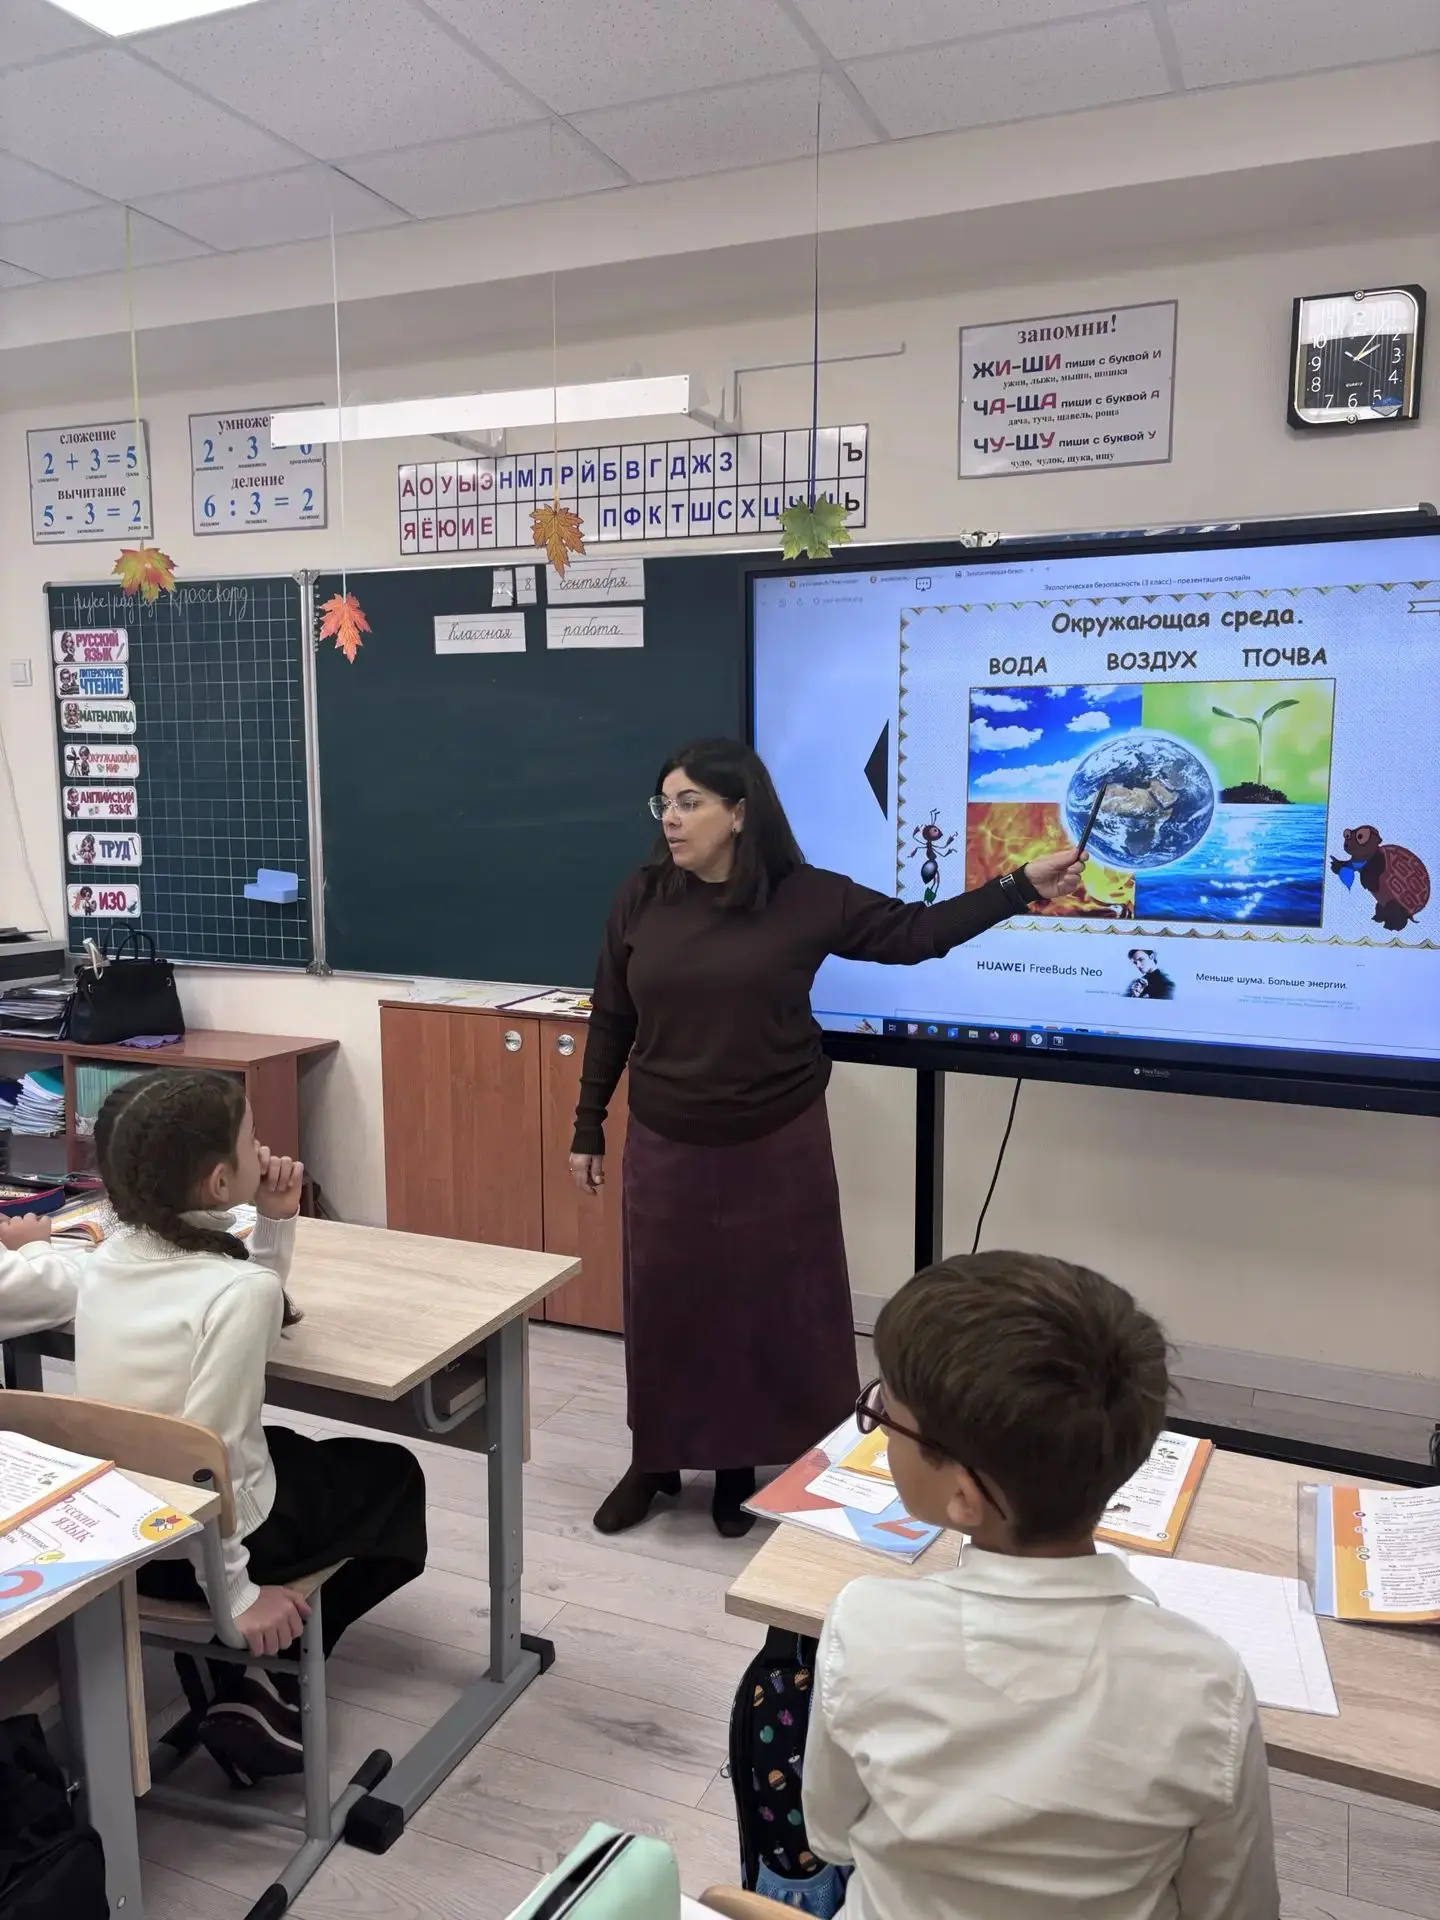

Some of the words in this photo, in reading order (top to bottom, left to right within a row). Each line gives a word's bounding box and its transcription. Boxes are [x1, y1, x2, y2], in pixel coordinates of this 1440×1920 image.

[1017, 314, 1117, 344] запомни!
[1312, 333, 1327, 349] 10
[972, 353, 1062, 379] ЖИ-ШИ
[1065, 359, 1096, 369] пиши
[1098, 357, 1105, 365] с
[1109, 351, 1149, 366] буквой
[1152, 349, 1161, 359] И
[1311, 356, 1321, 372] 9
[1391, 347, 1401, 364] 3
[1311, 376, 1321, 393] 8
[1388, 369, 1399, 385] 4
[1061, 398, 1092, 409] пиши
[1095, 397, 1102, 405] с
[1105, 391, 1147, 406] буквой
[1150, 390, 1160, 399] А
[1324, 394, 1334, 409] 7
[1347, 393, 1358, 409] 6
[217, 415, 271, 435] умноже
[1007, 416, 1031, 426] дача,
[1032, 414, 1055, 425] туча,
[1095, 408, 1119, 420] роща
[59, 429, 117, 445] сложение
[1058, 437, 1090, 448] пиши
[1093, 436, 1100, 445] с
[1103, 431, 1145, 446] буквой
[1148, 430, 1157, 439] У
[203, 439, 215, 463] 2
[246, 435, 259, 460] 3
[43, 452, 55, 475] 2
[90, 448, 101, 472] 3
[126, 445, 138, 469] 5
[1036, 456, 1065, 467] чулок,
[230, 473, 285, 490] деление
[57, 486, 127, 500] вычитание
[204, 494, 216, 518] 6
[249, 491, 261, 516] 3
[302, 487, 314, 512] 2
[43, 504, 55, 527] 5
[84, 502, 96, 525] 3
[132, 499, 142, 523] 2
[524, 577, 533, 591] 8
[1043, 583, 1093, 592] Экологическая
[1094, 579, 1140, 589] безопасность
[1150, 577, 1173, 587] класс)
[1177, 576, 1223, 586] презентация
[1224, 574, 1251, 582] онлайн
[448, 621, 513, 641] Классная
[1051, 612, 1210, 638] Окружающая
[1220, 608, 1304, 632] среда.
[75, 629, 119, 648] РУССКИЙ
[84, 647, 113, 662] ЯЗЫК
[989, 656, 1048, 676] ВОДА
[1106, 650, 1198, 672] ВОЗДУХ
[1242, 647, 1328, 668] ПОЧВА
[79, 667, 124, 678] ЛИТЕРАТУРНОЕ
[79, 678, 124, 695] ЧТЕНИЕ
[79, 709, 135, 723] МАТЕМАТИКА
[106, 763, 120, 773] МИР
[80, 789, 135, 804] АНГЛИЙСКИЙ
[108, 803, 132, 815] ЯЗЫК
[99, 840, 131, 861] ТРУД
[98, 891, 127, 911] ИЗО
[976, 960, 1026, 973] HUAWEI
[1029, 963, 1077, 976] FreeBuds
[1080, 966, 1103, 977] Neo
[1195, 972, 1234, 983] Меньше
[1236, 976, 1265, 986] шума.
[1268, 976, 1305, 987] Больше
[1307, 979, 1348, 990] энергии.
